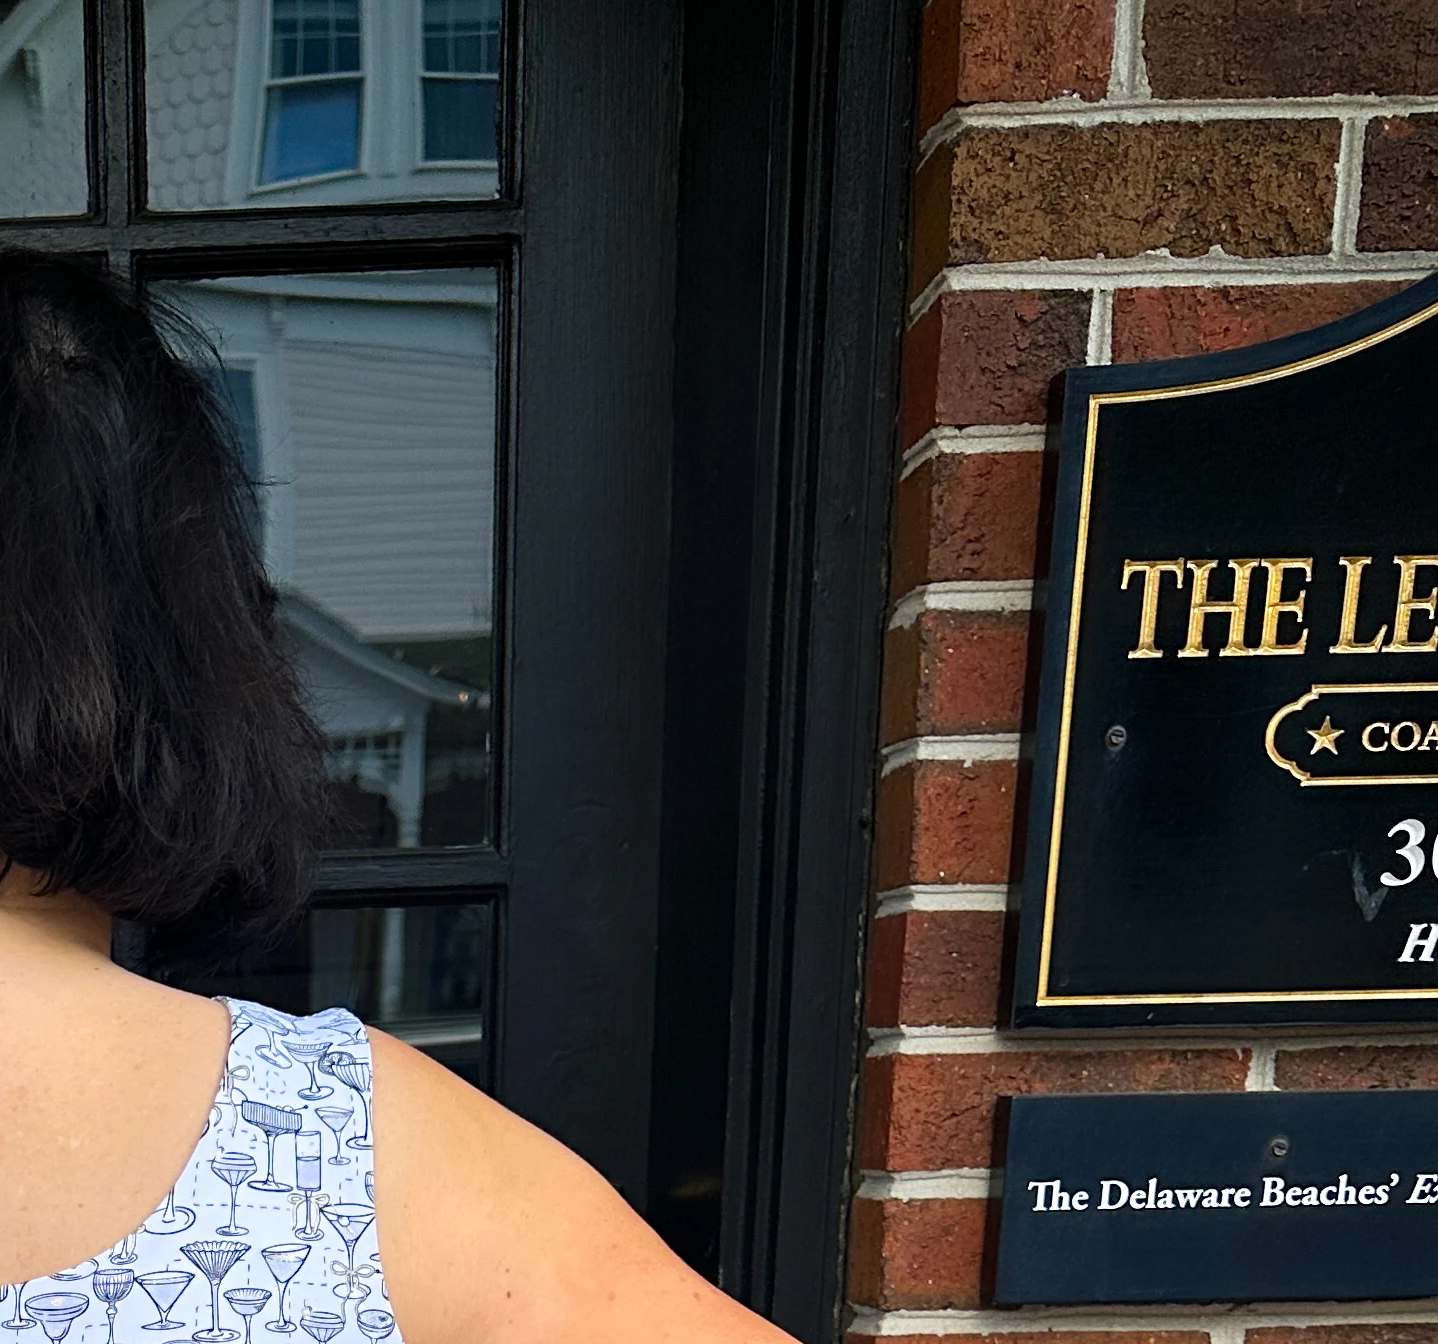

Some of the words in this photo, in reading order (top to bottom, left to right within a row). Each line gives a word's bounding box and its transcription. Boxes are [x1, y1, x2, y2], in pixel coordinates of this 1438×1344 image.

[1120, 557, 1313, 660] THE
[1328, 554, 1438, 654] LE
[1379, 818, 1438, 887] 3
[1027, 1179, 1090, 1212] The
[1096, 1177, 1252, 1210] Delaware
[1259, 1172, 1400, 1207] Beaches’
